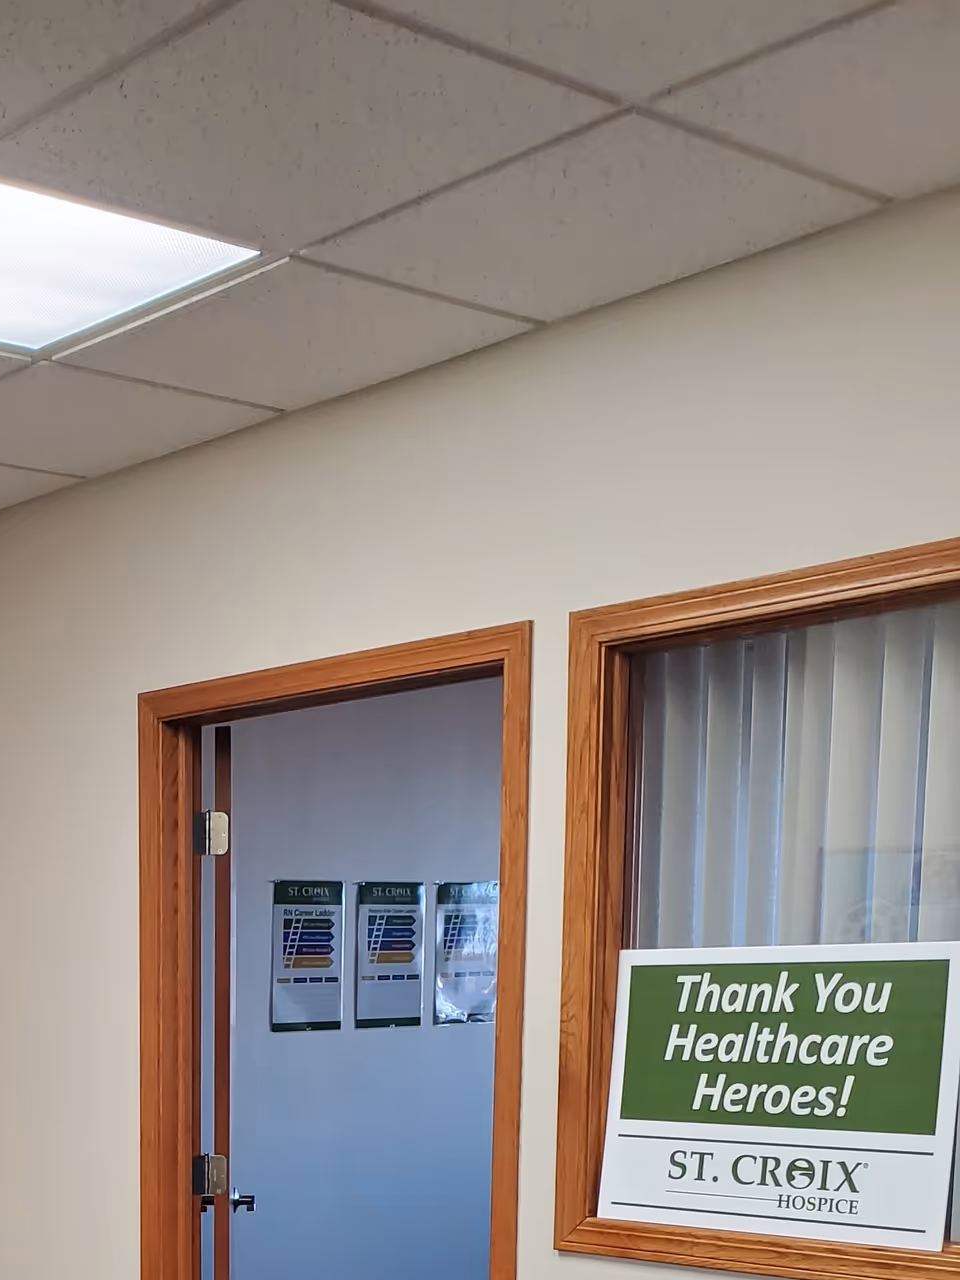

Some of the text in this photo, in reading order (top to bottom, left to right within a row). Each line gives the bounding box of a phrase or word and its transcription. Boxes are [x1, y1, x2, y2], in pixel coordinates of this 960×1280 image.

[288, 886, 330, 897] ST. CROIX
[372, 887, 411, 897] ST. CROIX
[283, 908, 293, 917] RN
[676, 971, 893, 1013] Thank You
[664, 1022, 894, 1066] Healthcare
[691, 1073, 856, 1117] Heroes!
[667, 1150, 719, 1183] ST.
[776, 1193, 859, 1215] HOSPICE
